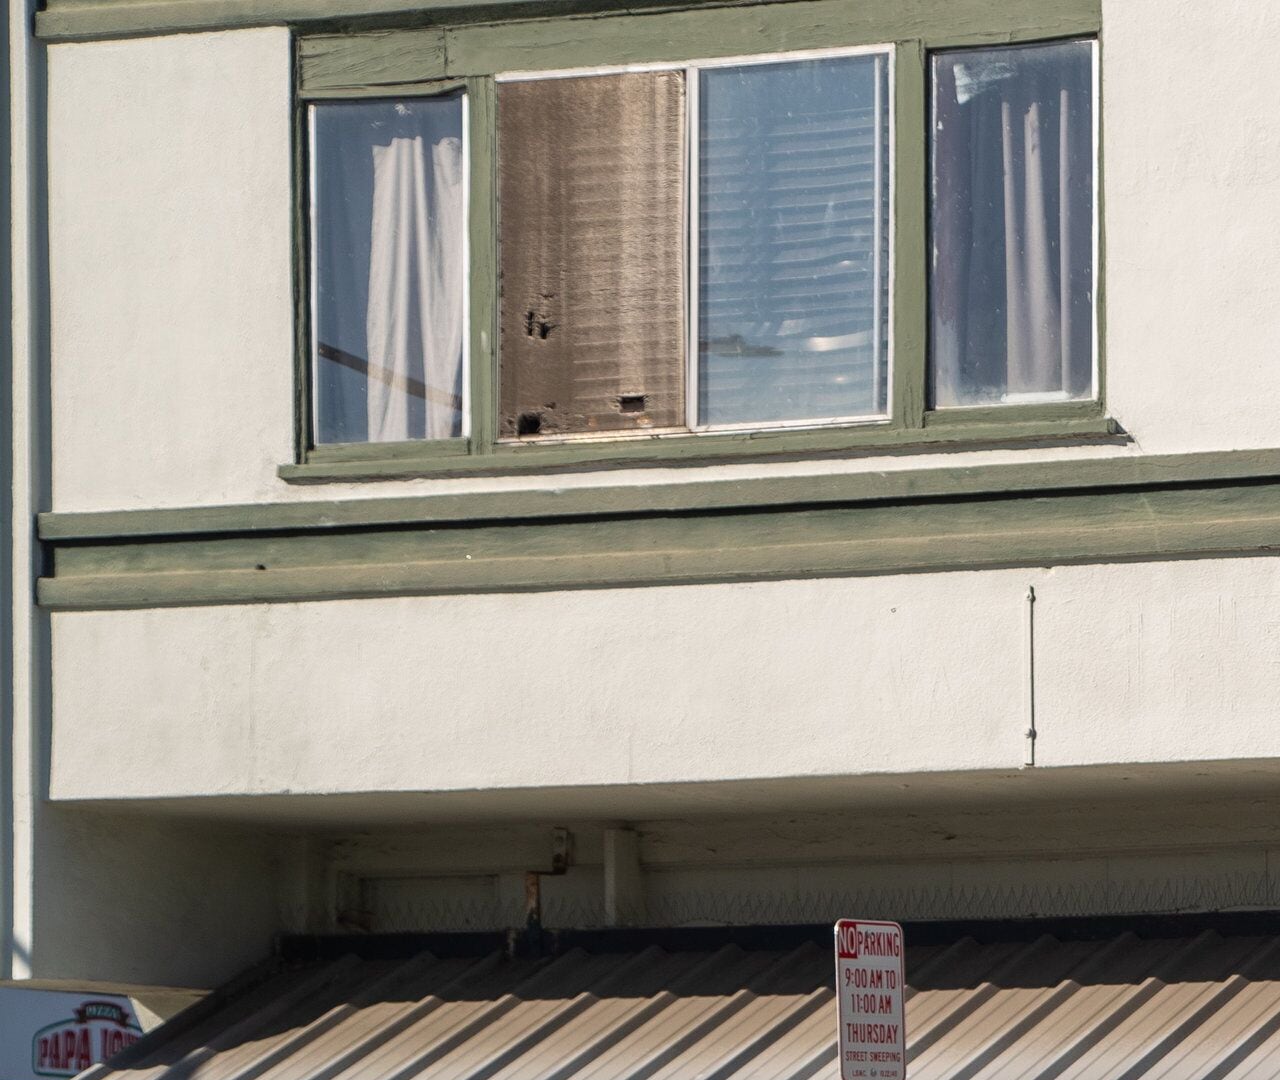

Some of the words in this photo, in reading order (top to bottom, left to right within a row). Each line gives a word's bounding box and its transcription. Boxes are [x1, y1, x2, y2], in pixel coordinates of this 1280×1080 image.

[839, 927, 857, 954] NO
[857, 931, 899, 957] PARKING
[845, 968, 867, 989] 9:00
[870, 970, 883, 989] AM
[884, 970, 896, 989] TO
[851, 994, 877, 1014] 11:00
[879, 995, 892, 1014] AM
[846, 1022, 899, 1044] THURSDAY
[37, 1028, 91, 1070] PAPA
[845, 1051, 868, 1062] STREET
[870, 1052, 901, 1063] SWEEPING
